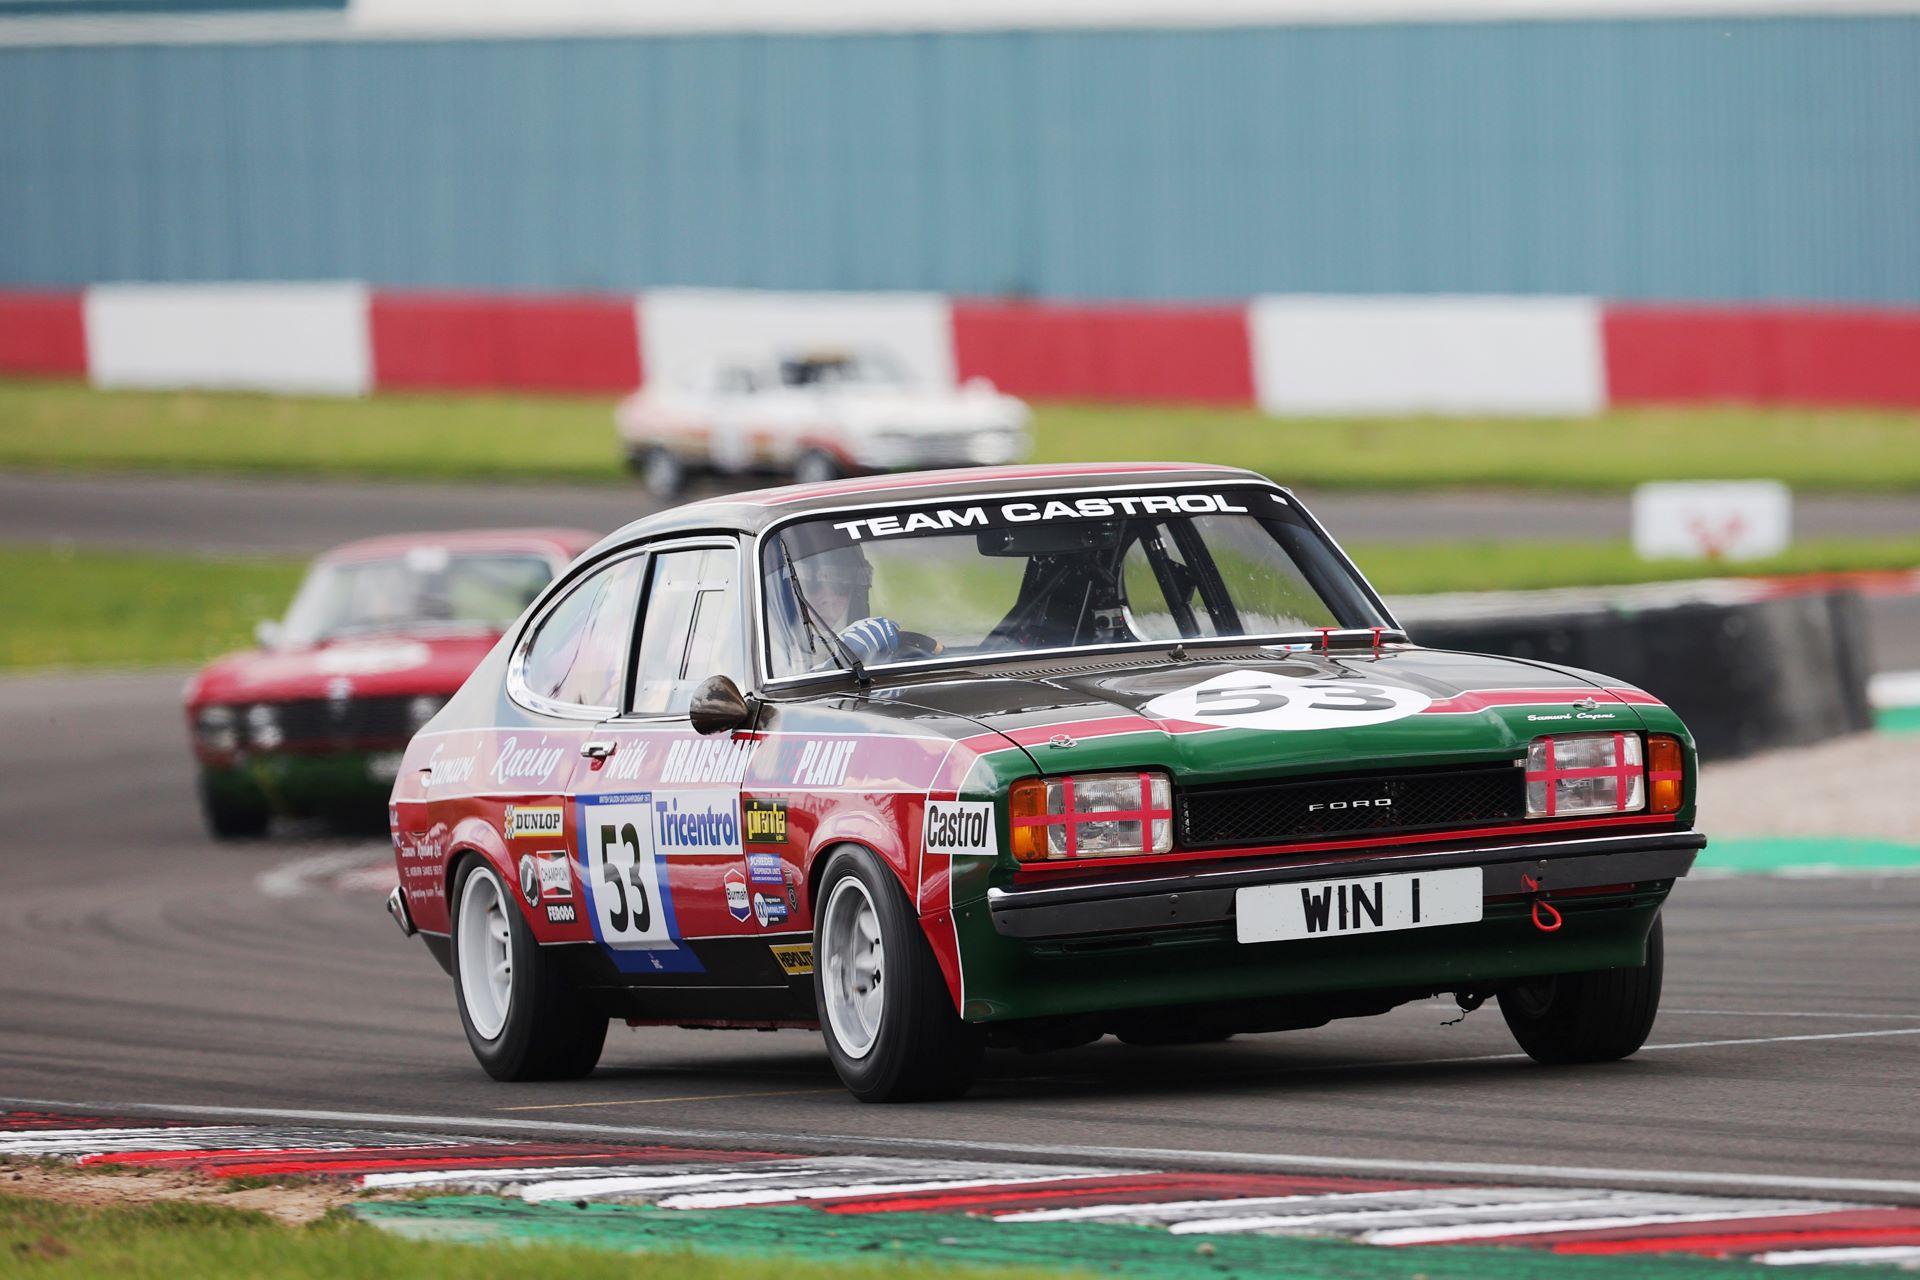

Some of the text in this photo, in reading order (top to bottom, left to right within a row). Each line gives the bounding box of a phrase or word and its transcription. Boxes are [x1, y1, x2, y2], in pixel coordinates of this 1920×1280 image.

[834, 495, 1248, 539] TEAM CASTROL
[1194, 685, 1397, 716] 53
[1527, 712, 1615, 721] Samuri Capri
[490, 736, 564, 785] Racing
[660, 739, 762, 783] BRADSHAW
[792, 741, 857, 785] PLANT
[516, 813, 560, 830] DUNLOP
[747, 801, 786, 840] piranha
[1309, 798, 1391, 811] FORD
[655, 798, 739, 847] Tricentrol
[927, 805, 989, 847] Castrol
[541, 867, 569, 882] CHAMPION
[601, 822, 650, 933] 53
[726, 887, 746, 901] Burmah
[1300, 882, 1383, 933] WIN
[547, 905, 575, 921] FERODO
